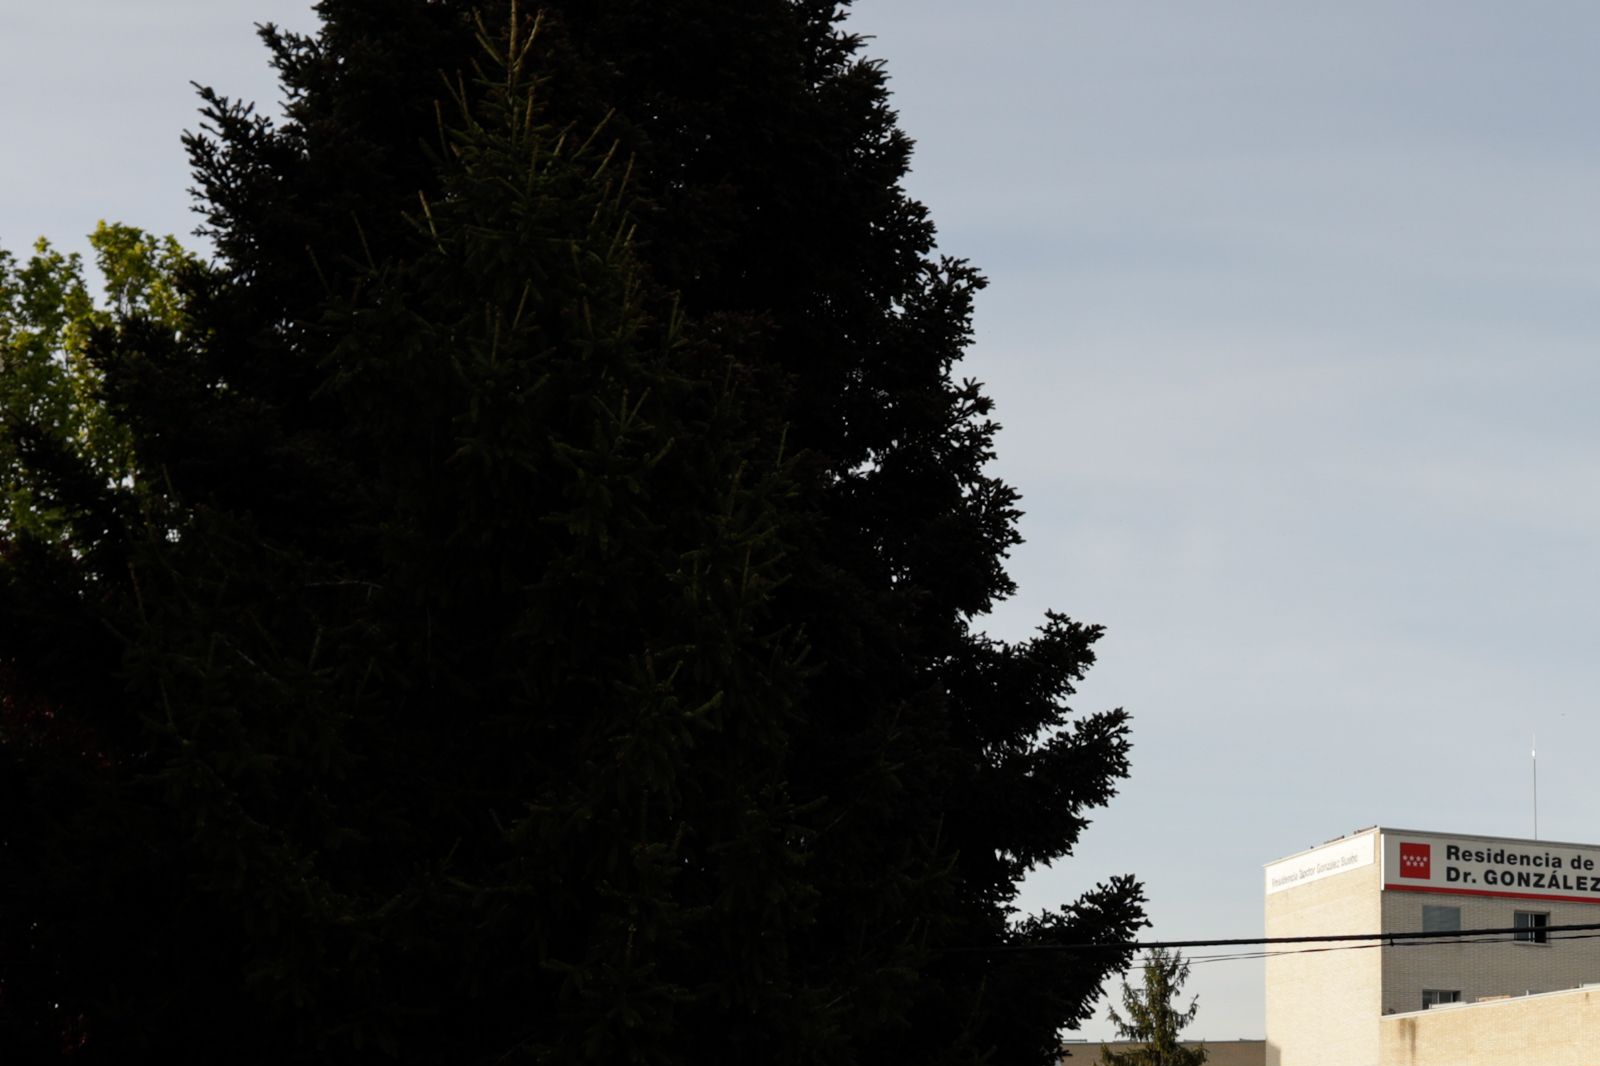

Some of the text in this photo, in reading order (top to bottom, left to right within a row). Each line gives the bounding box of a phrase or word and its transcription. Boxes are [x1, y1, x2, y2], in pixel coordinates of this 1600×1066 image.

[1446, 845, 1562, 868] Residencia
[1570, 852, 1594, 870] de
[1446, 867, 1477, 884] Dr.
